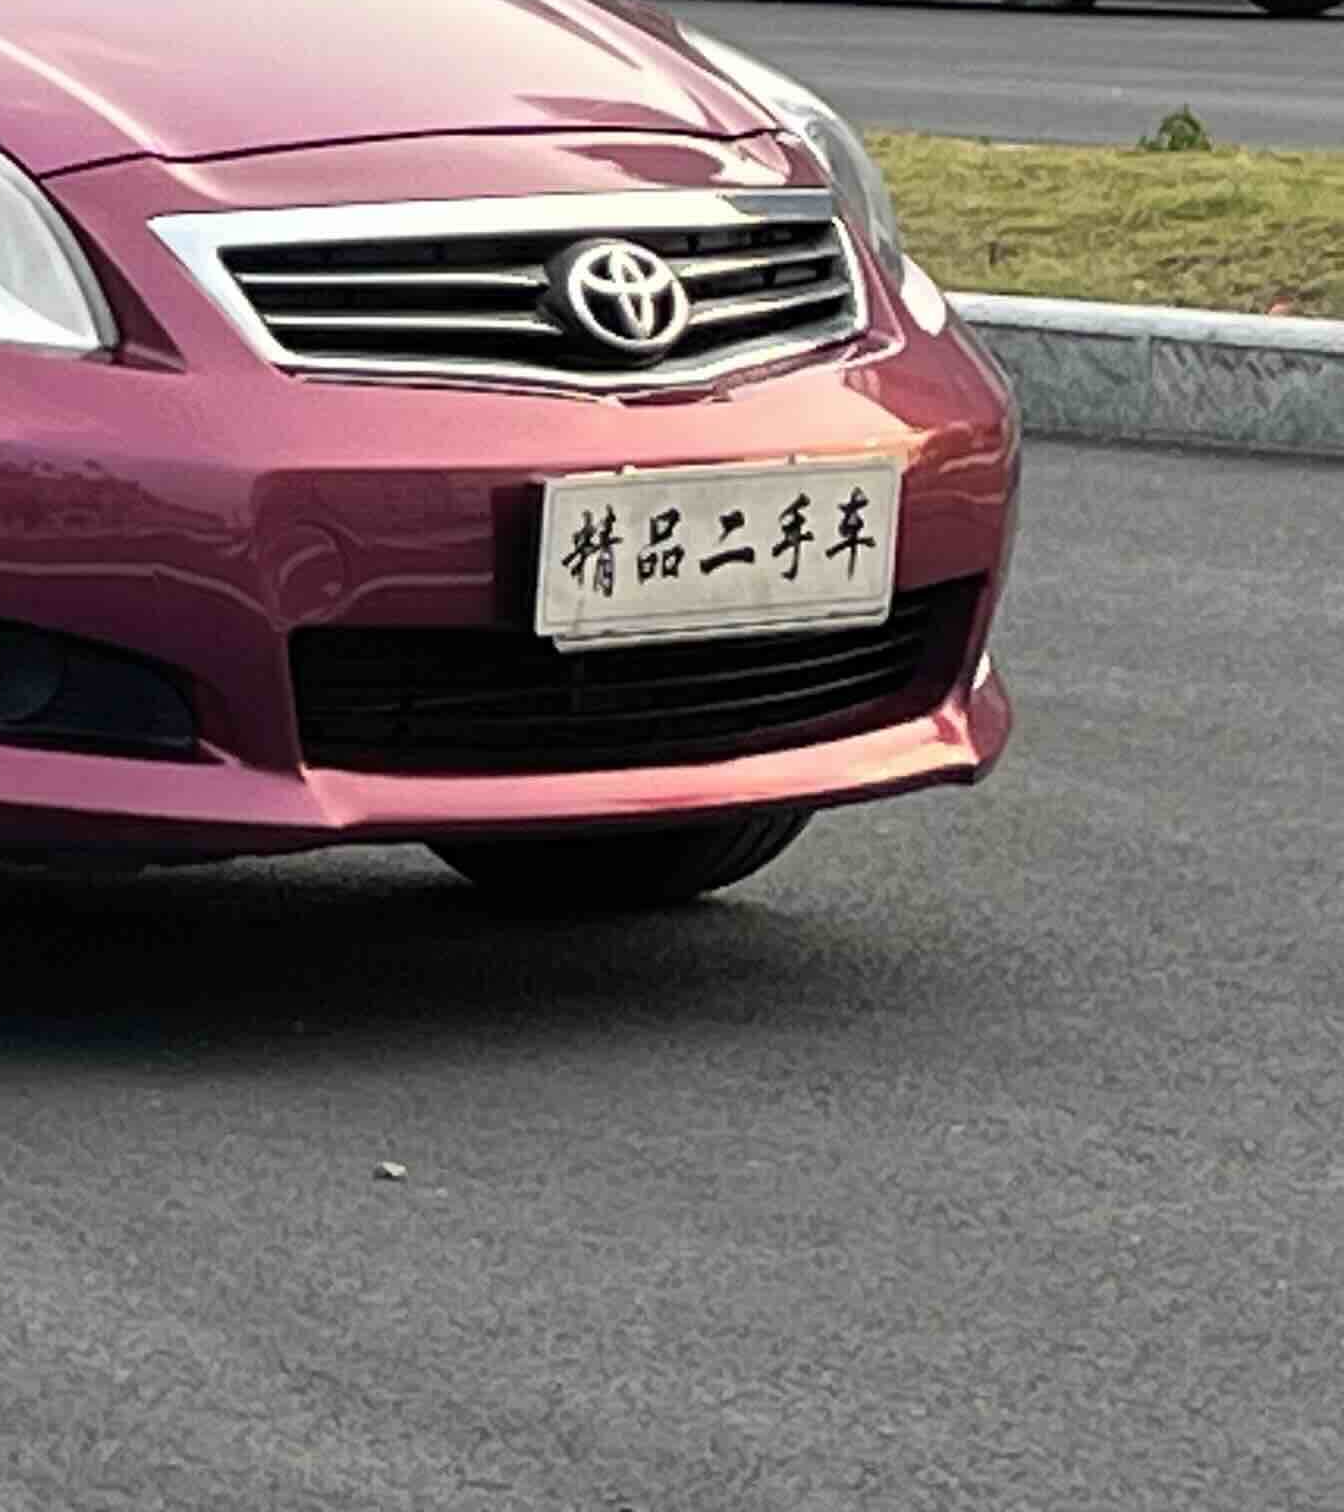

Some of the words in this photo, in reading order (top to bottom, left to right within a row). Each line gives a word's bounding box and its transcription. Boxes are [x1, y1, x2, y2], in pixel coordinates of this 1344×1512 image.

[561, 487, 876, 598] 精品二手车
